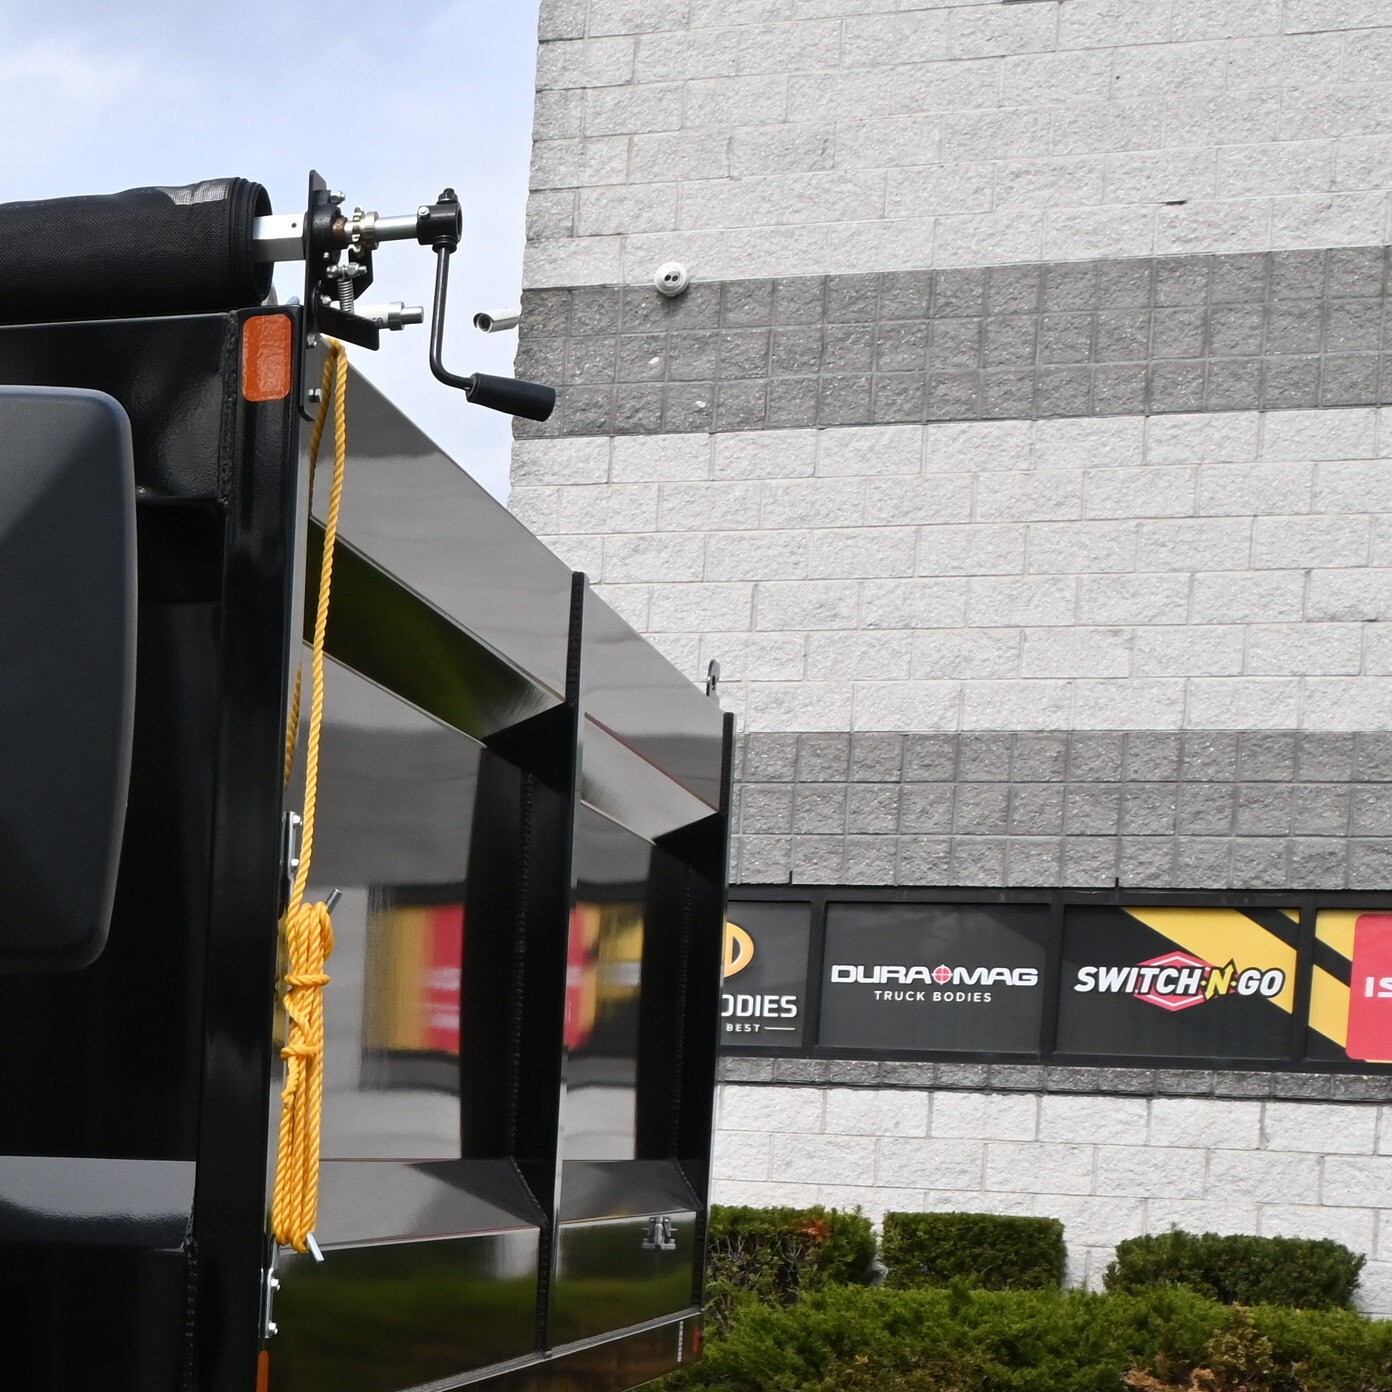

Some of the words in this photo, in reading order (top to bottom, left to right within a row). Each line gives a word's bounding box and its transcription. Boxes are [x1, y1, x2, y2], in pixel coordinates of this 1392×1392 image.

[874, 990, 926, 1001] TRUCK
[932, 991, 993, 1003] BODIES
[726, 1023, 760, 1032] BEST
